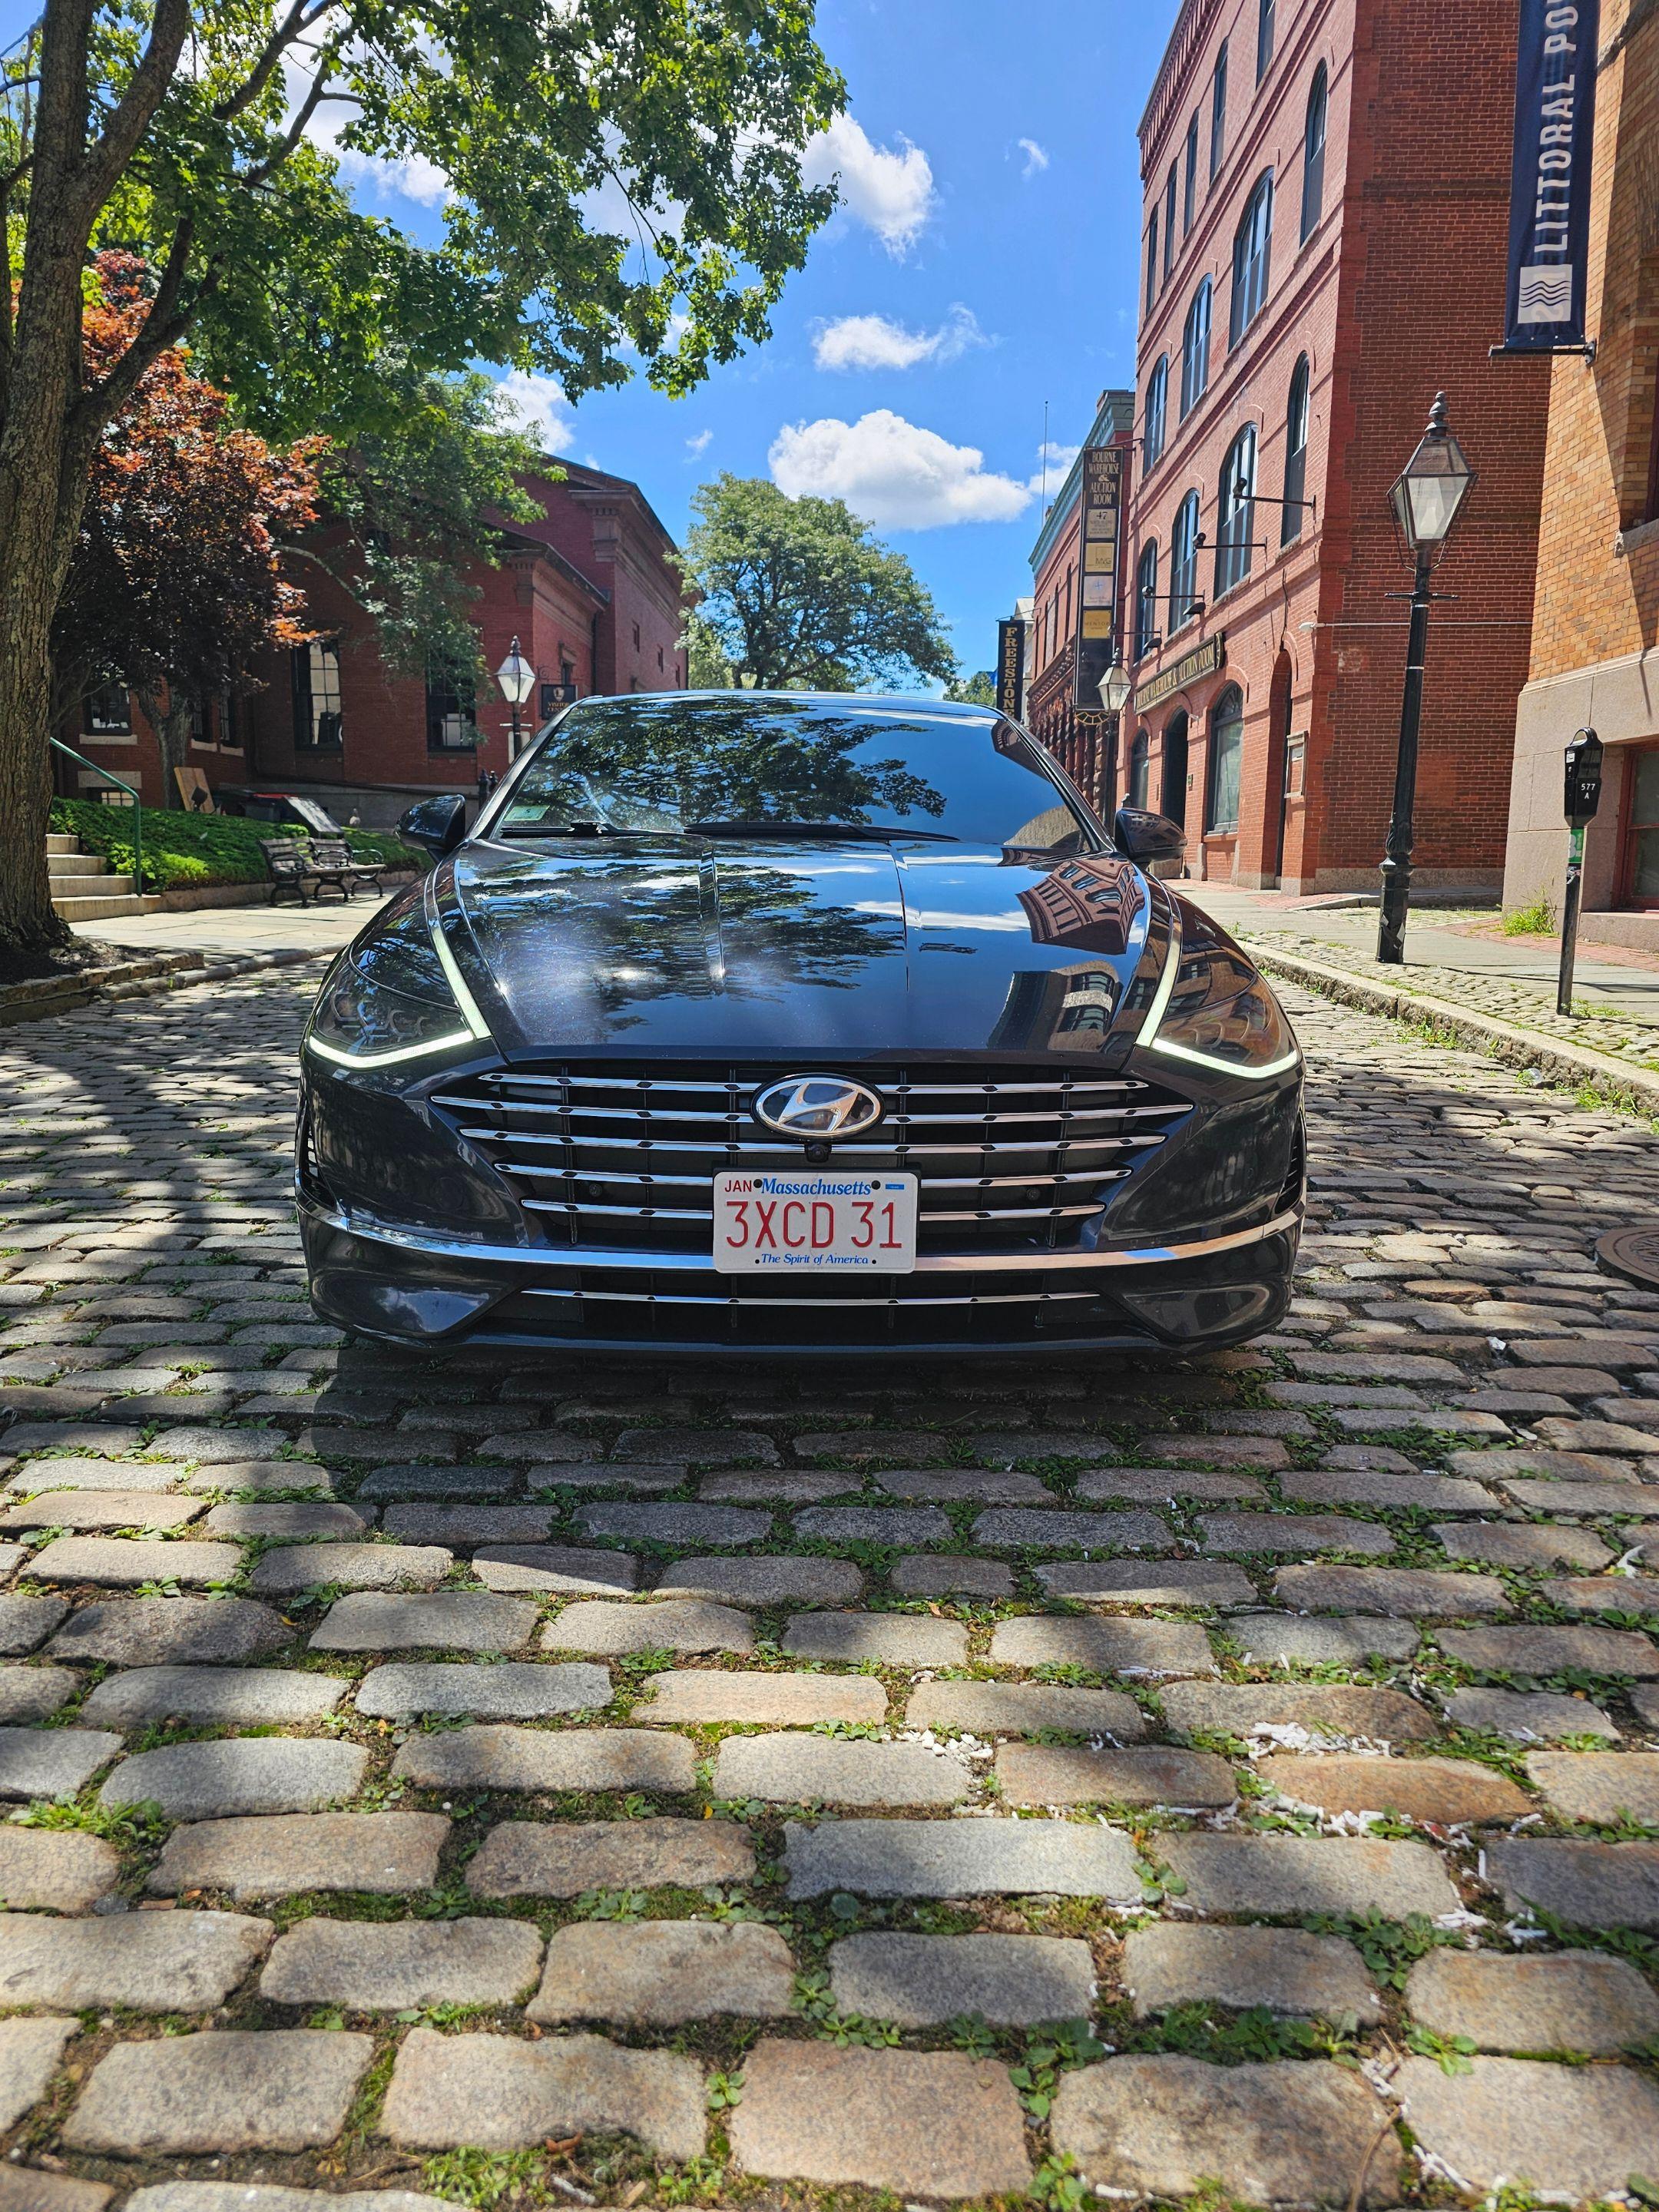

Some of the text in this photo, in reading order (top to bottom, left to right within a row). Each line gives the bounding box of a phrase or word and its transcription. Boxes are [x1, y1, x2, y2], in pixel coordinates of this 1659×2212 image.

[1535, 0, 1579, 252] LITTORAL PO
[1092, 452, 1117, 462] BOURNE
[1088, 462, 1120, 475] WAREHOUSE
[1098, 474, 1110, 482] &
[1091, 482, 1117, 493] AUCTION
[1093, 493, 1112, 505] ROOM
[1096, 511, 1108, 520] 47
[724, 1180, 752, 1193] JAN
[761, 1177, 872, 1196] Massachusetts
[726, 1200, 902, 1249] 3XCD 31
[761, 1253, 869, 1266] The Spirit of America
